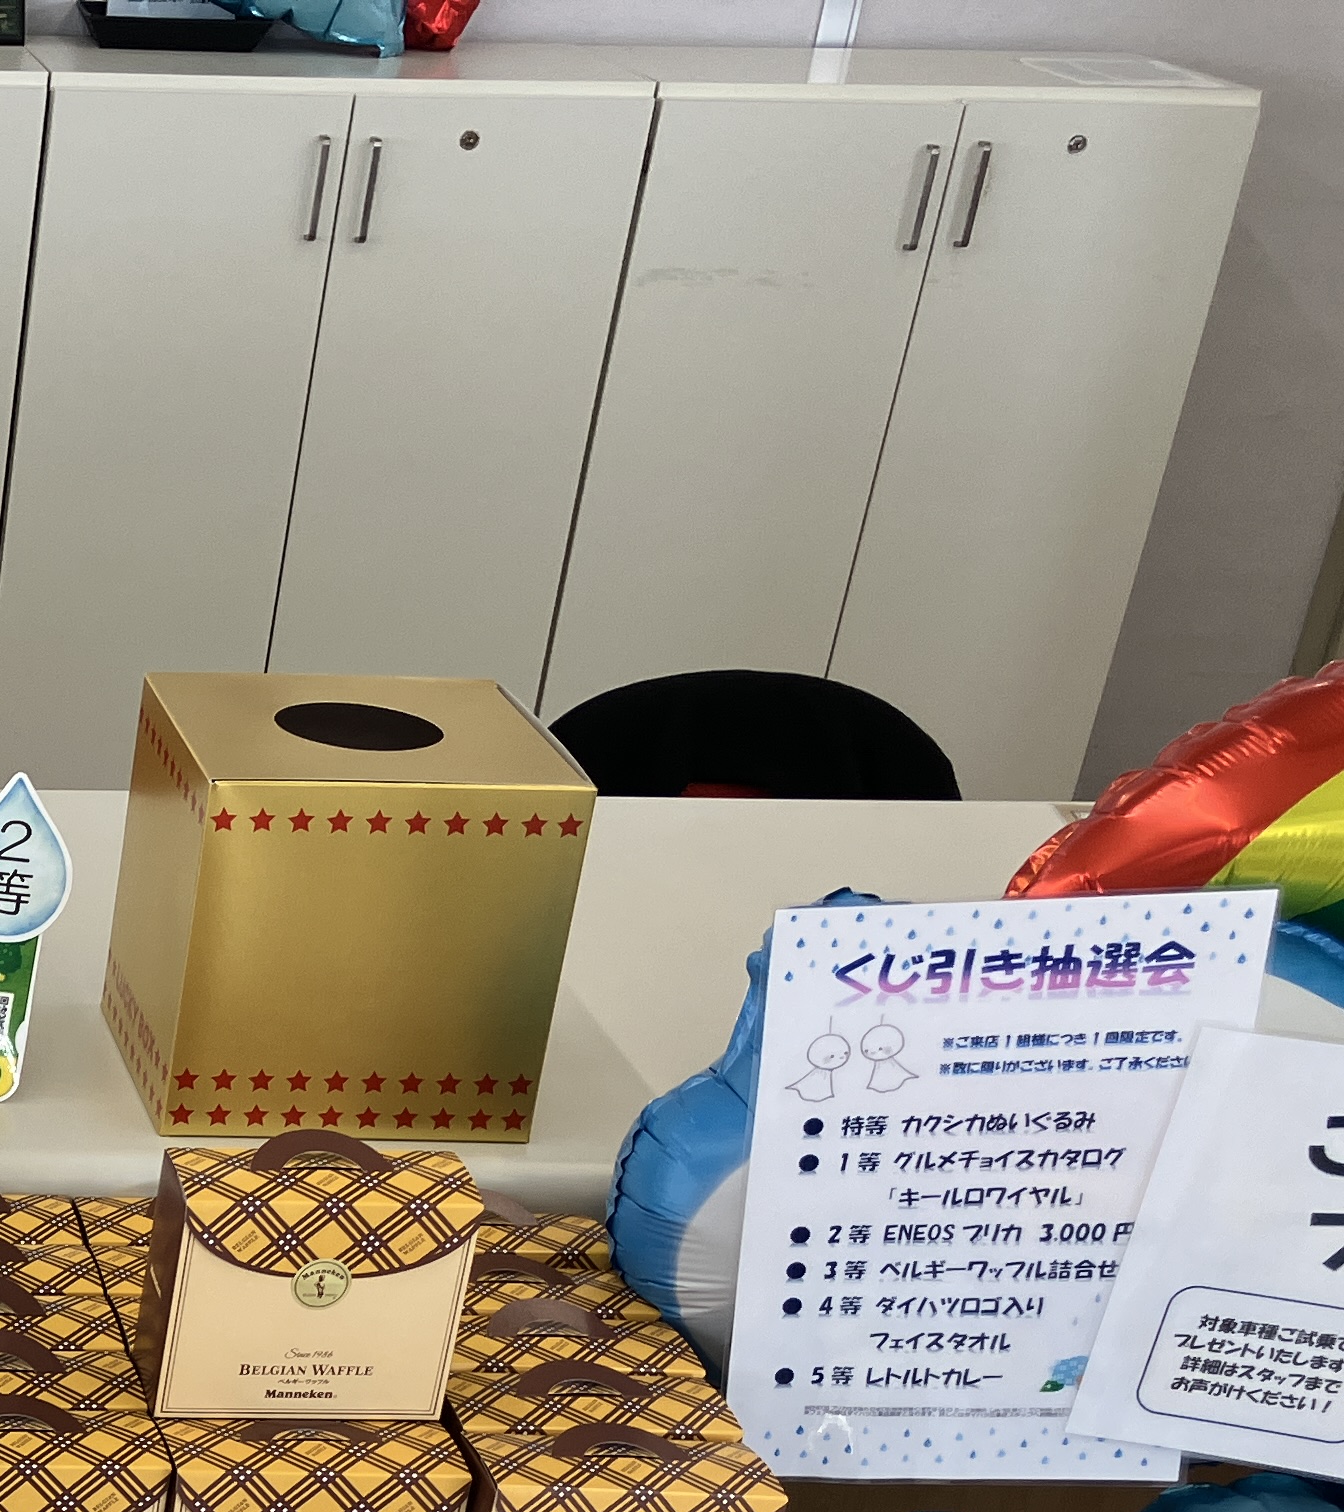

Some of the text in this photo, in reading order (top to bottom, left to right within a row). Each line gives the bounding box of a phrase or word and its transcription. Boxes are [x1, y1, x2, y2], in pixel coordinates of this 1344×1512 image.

[835, 940, 1197, 995] くじ引き抽選会
[841, 1111, 1096, 1136] 特等 カクシカぬいぐるみ
[894, 1148, 1127, 1170] グルメチョイスカタログ
[889, 1187, 1084, 1207] 「キールロワイヤル」
[883, 1225, 955, 1243] ENEOS
[963, 1224, 1022, 1243] プリカ
[880, 1260, 1120, 1280] ベルギーワッフル詰合せ
[876, 1297, 1044, 1316] ダイハツロゴ入り
[869, 1332, 1011, 1351] フェイスタオル
[239, 1364, 374, 1376] BELGIAN WAFFLE
[866, 1367, 1004, 1387] レトルトカレー
[1180, 1355, 1342, 1394] 詳細はスタッフまで
[264, 1389, 334, 1399] Manneken
